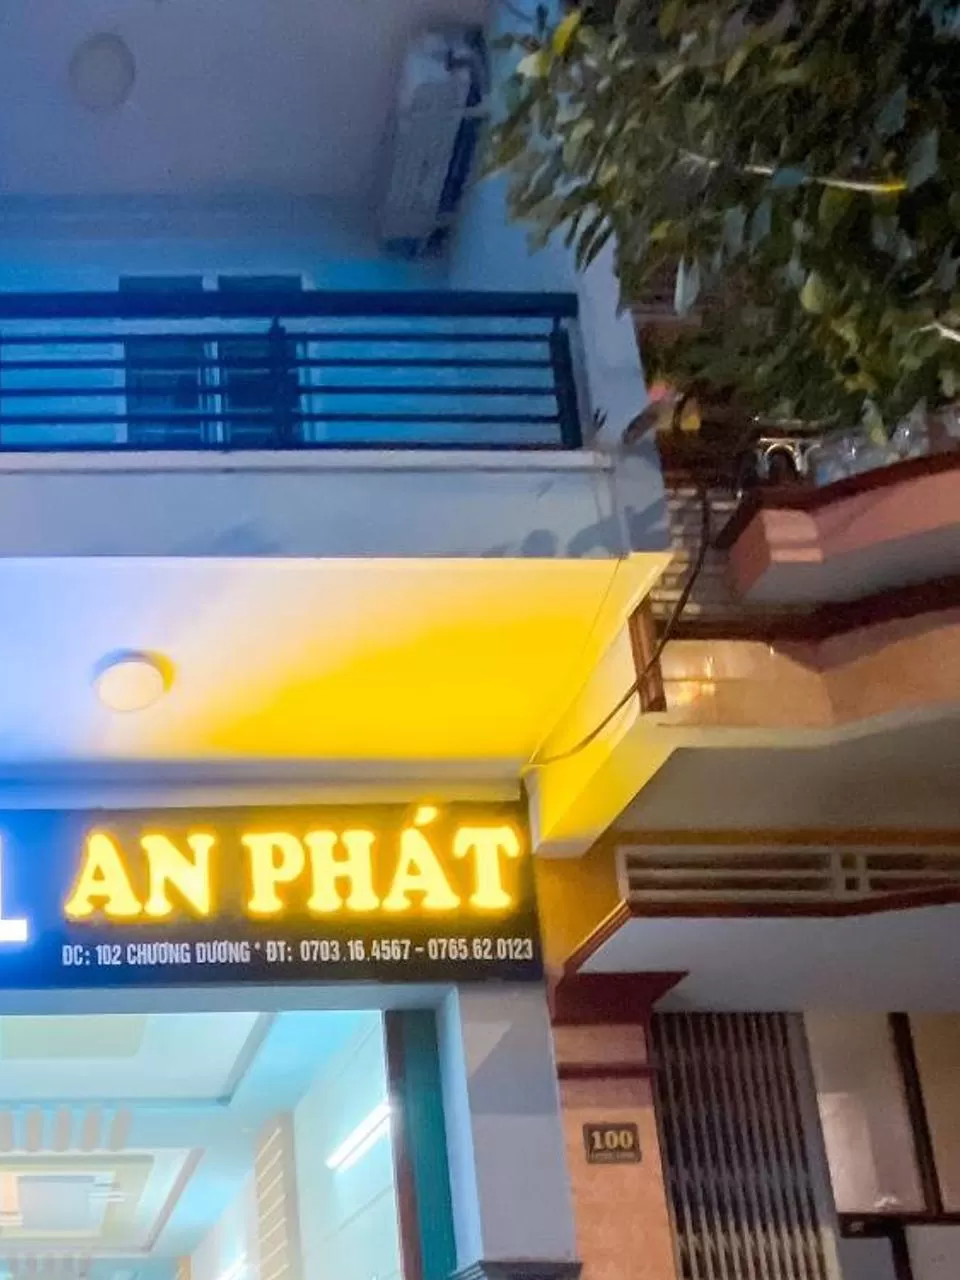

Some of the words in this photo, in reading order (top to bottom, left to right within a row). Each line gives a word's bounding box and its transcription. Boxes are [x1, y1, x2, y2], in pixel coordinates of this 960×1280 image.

[64, 827, 215, 918] AN
[242, 805, 522, 914] PHÁT
[96, 944, 122, 965] 102
[126, 941, 191, 965] CHƯƠNG
[195, 940, 251, 964] DƯƠNG
[266, 940, 293, 963] ĐT:
[591, 1131, 633, 1150] 100
